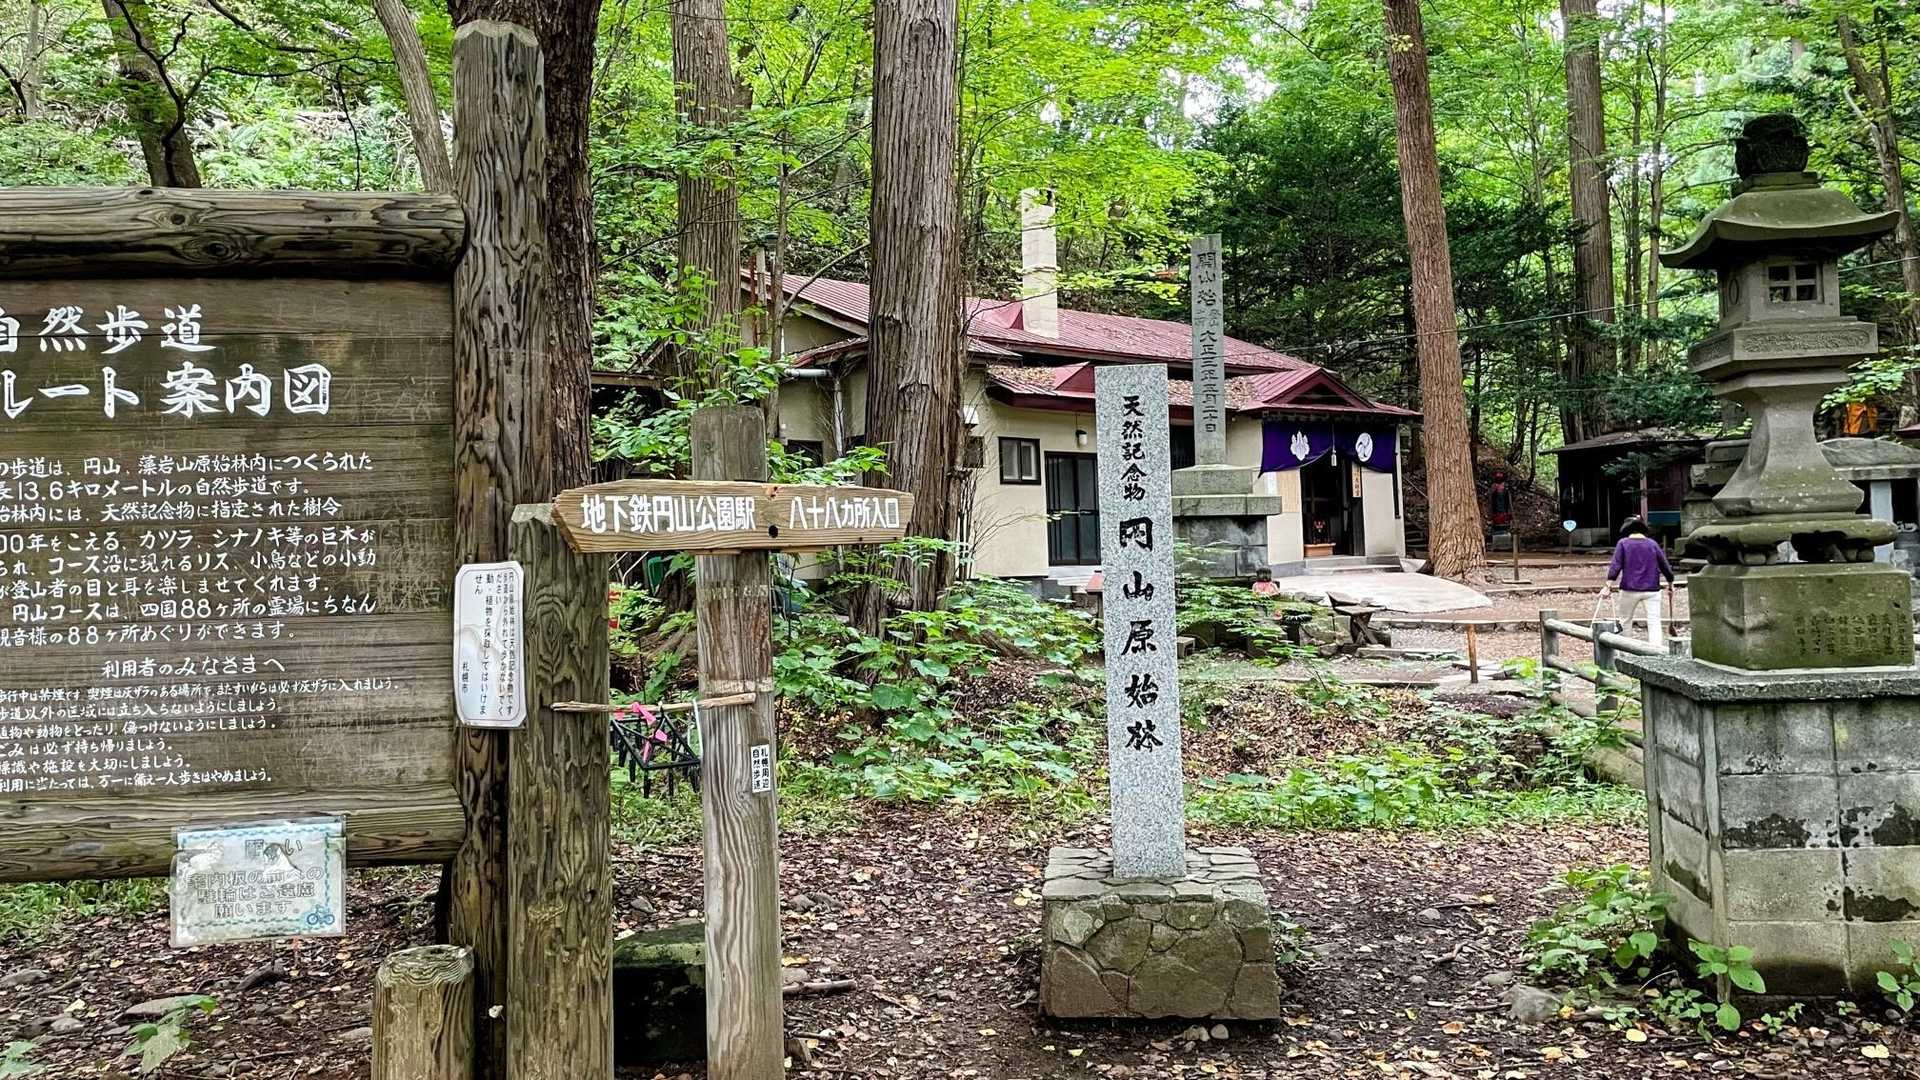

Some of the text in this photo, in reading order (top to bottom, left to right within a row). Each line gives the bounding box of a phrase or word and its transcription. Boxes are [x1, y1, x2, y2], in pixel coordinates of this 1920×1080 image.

[0, 304, 217, 354] 自然歩道
[0, 362, 332, 419] ルート案内図
[1120, 395, 1147, 501] 天然記念物
[581, 494, 756, 533] 地下鉄円山公園駅
[102, 654, 285, 678] 利用者のみなさまへ
